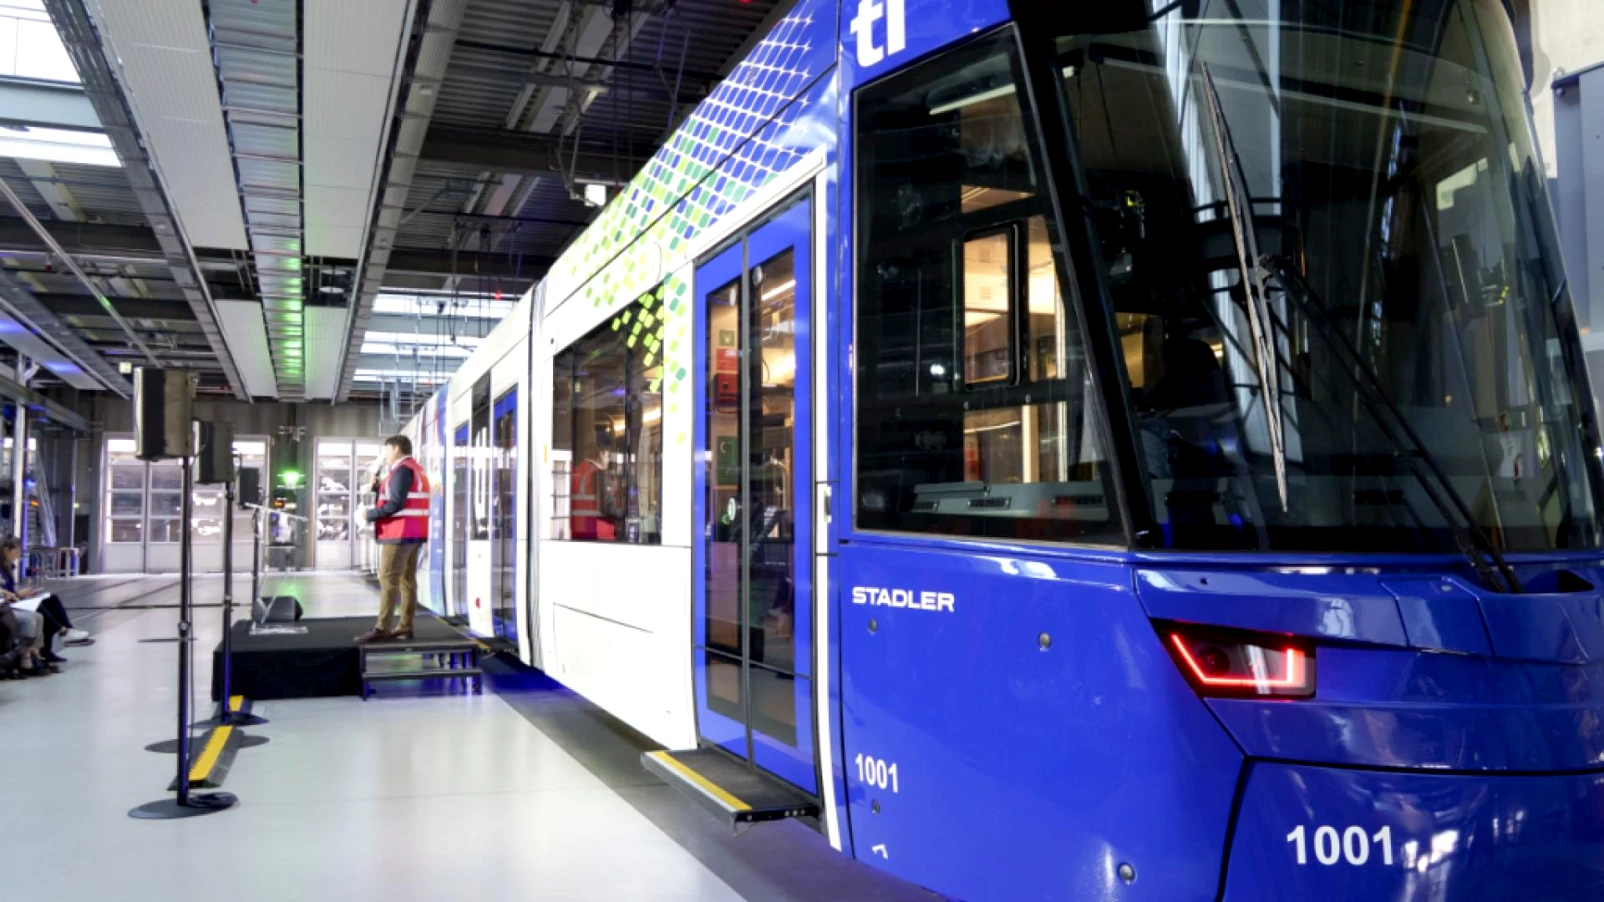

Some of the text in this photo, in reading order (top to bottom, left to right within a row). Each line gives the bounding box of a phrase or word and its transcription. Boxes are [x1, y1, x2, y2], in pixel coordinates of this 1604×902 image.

[852, 587, 955, 612] STADLER
[855, 753, 899, 793] 1001
[1286, 825, 1394, 866] 1001
